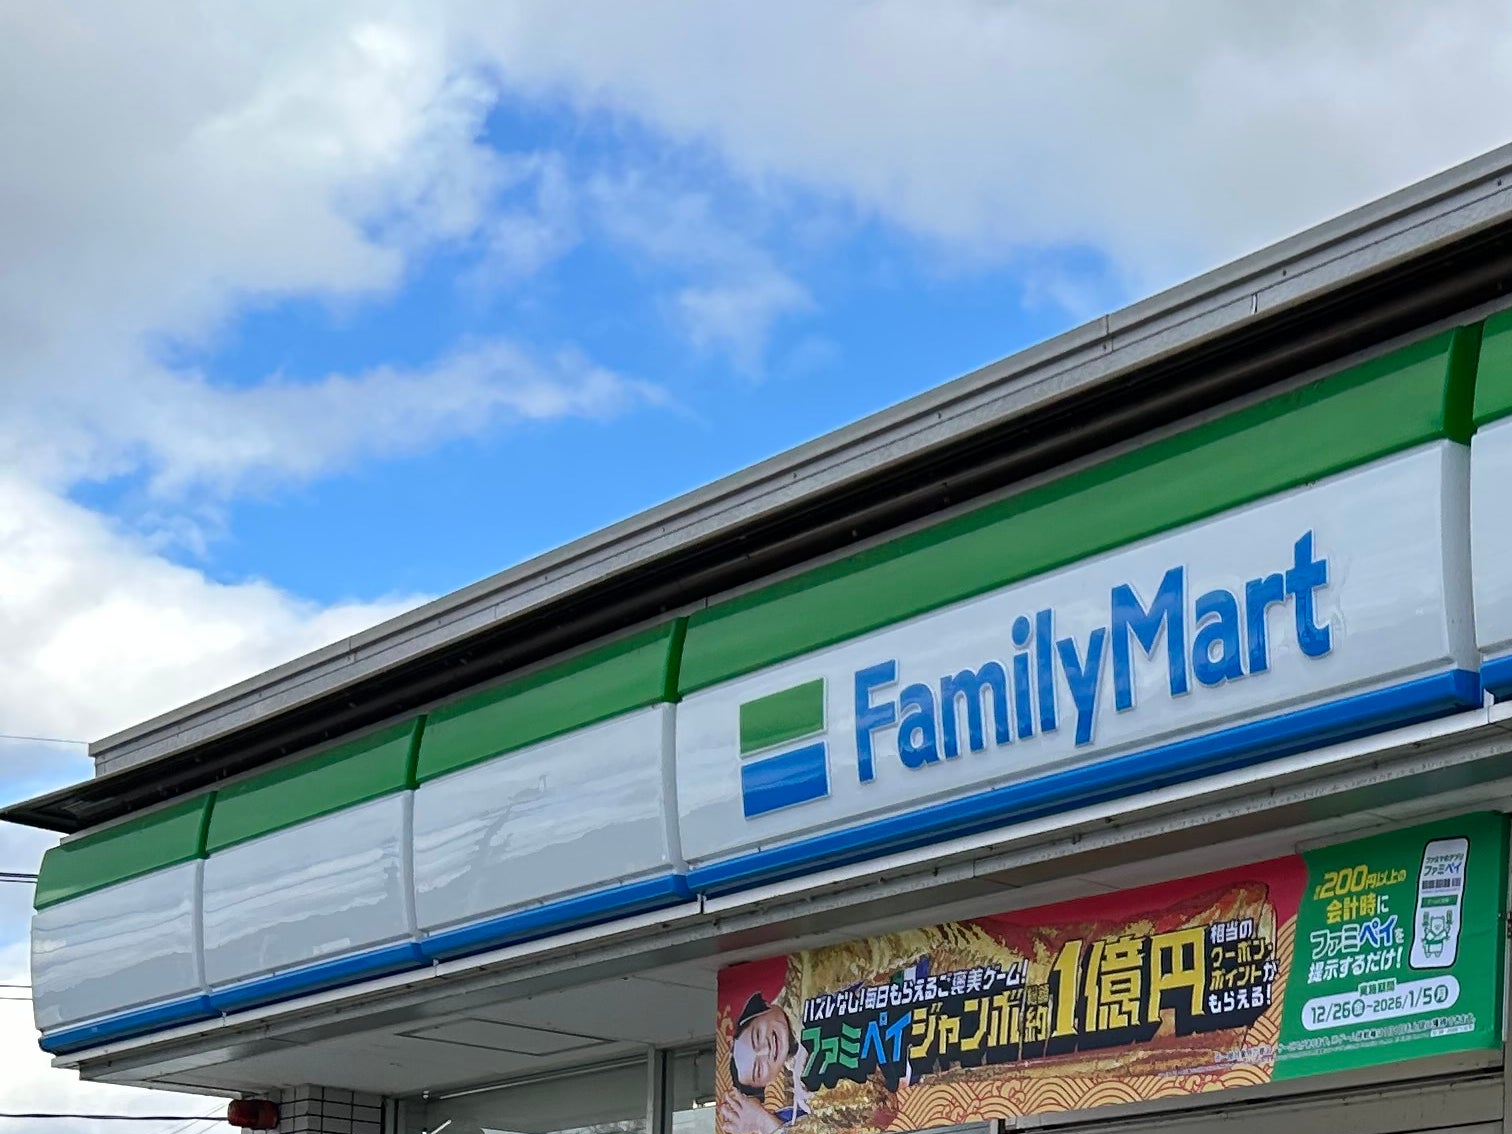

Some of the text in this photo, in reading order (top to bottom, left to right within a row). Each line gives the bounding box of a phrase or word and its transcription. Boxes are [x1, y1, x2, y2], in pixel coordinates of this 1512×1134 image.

[855, 530, 1335, 783] FamilyMart
[1424, 861, 1462, 877] ファミペイ
[1326, 894, 1389, 924] 会計時に
[1209, 919, 1253, 945] 相当の
[1209, 961, 1278, 991] ポイントが
[1208, 984, 1271, 1015] もらえる!
